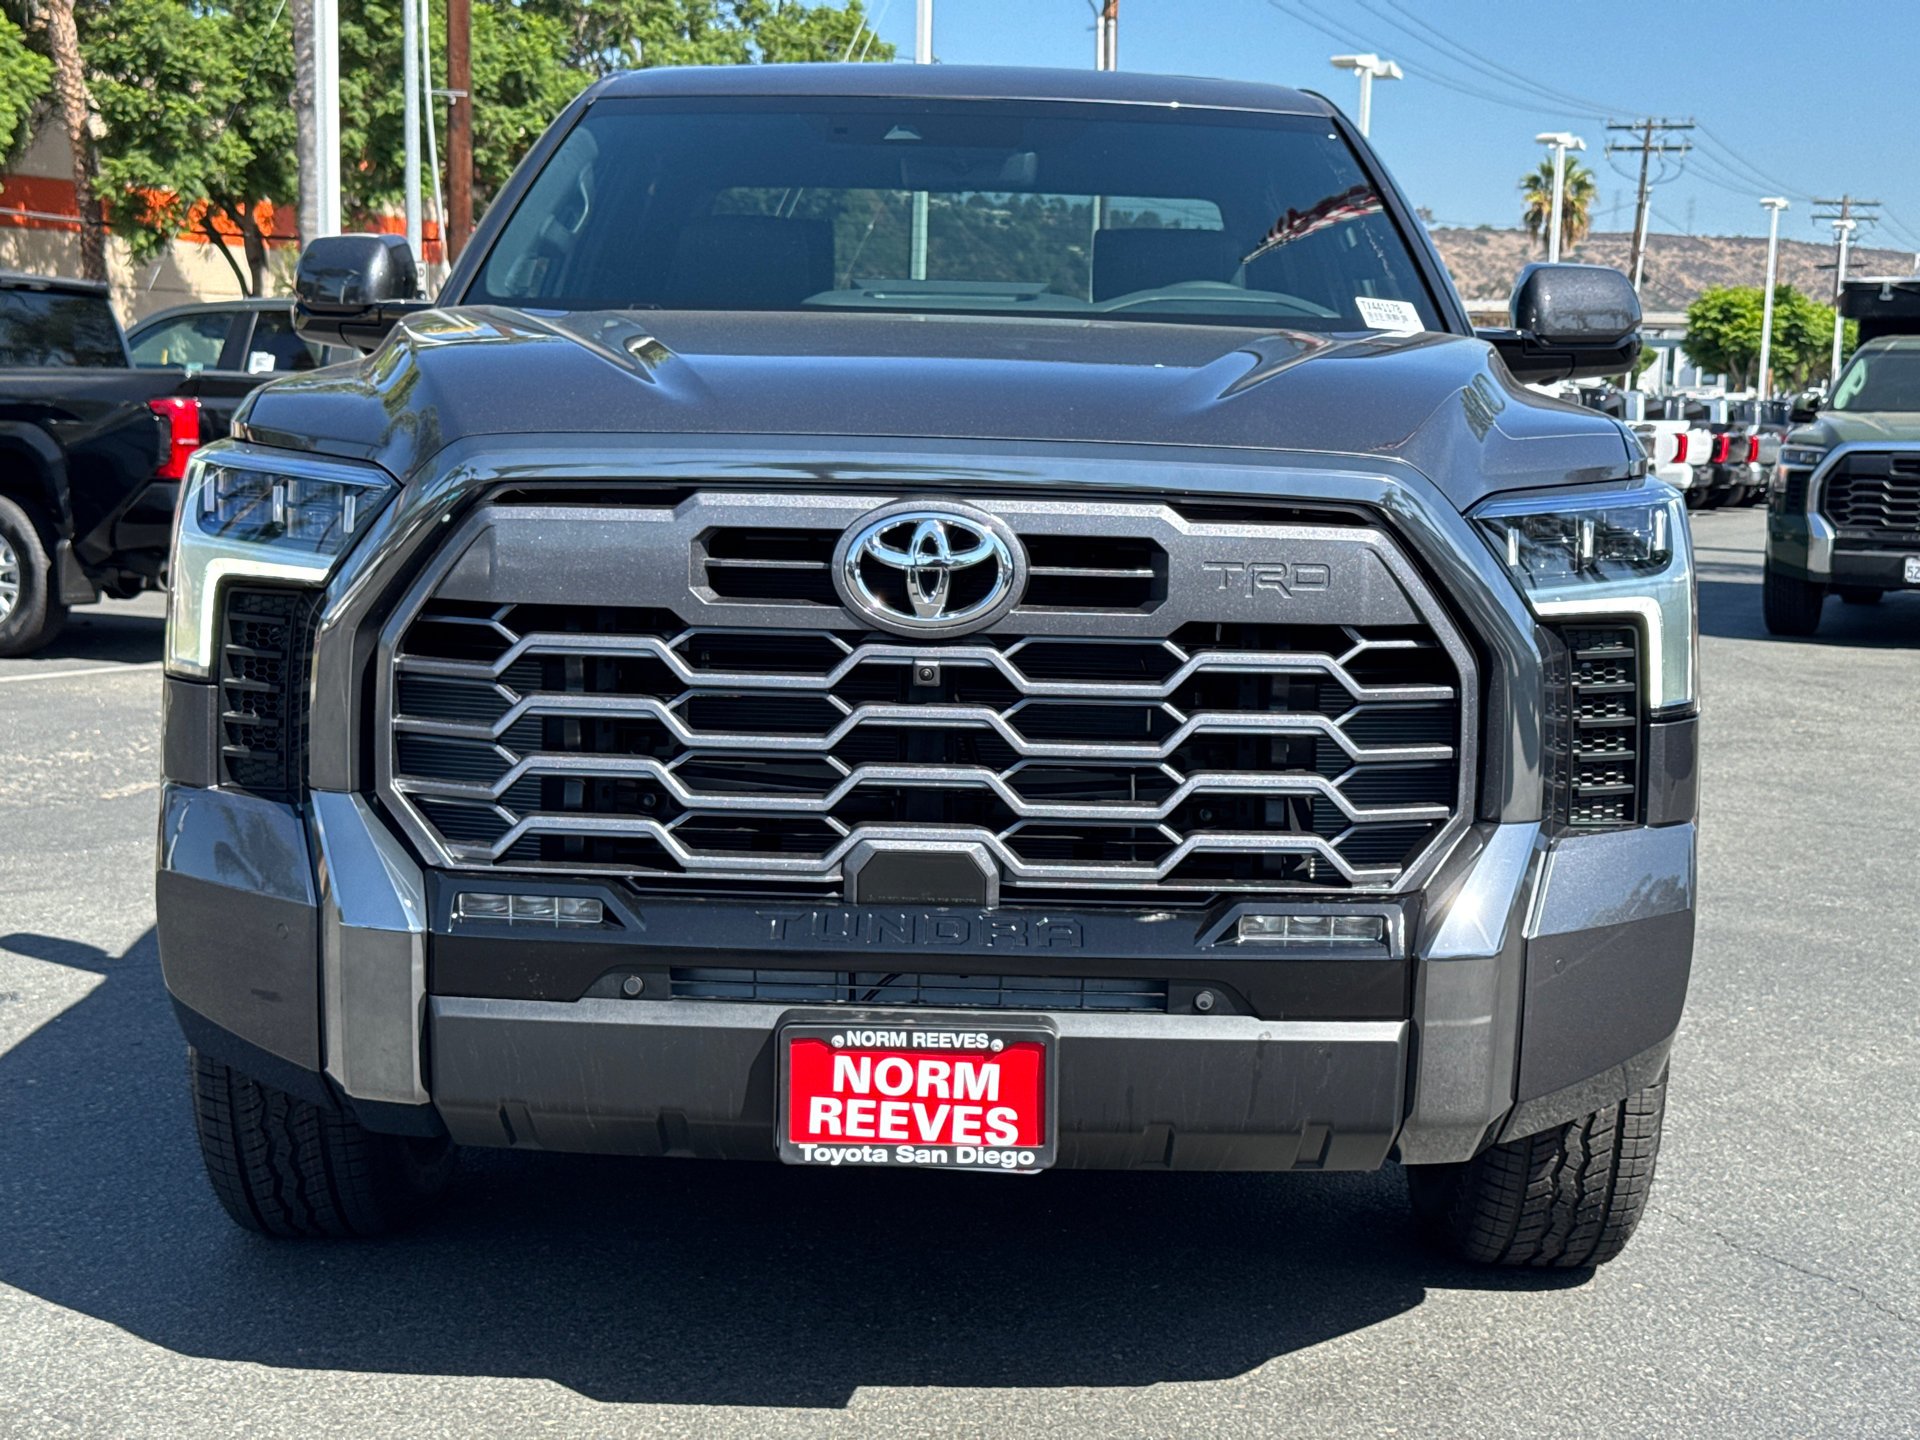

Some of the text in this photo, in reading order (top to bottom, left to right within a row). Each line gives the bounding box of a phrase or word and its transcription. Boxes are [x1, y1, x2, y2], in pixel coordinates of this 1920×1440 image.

[1202, 561, 1331, 599] TRD
[755, 910, 1084, 948] TUNDRA
[847, 1030, 989, 1049] NORM REEVES
[832, 1055, 1000, 1102] NORM
[808, 1096, 1019, 1146] REEVES
[798, 1143, 1036, 1169] Toyota San Diego
